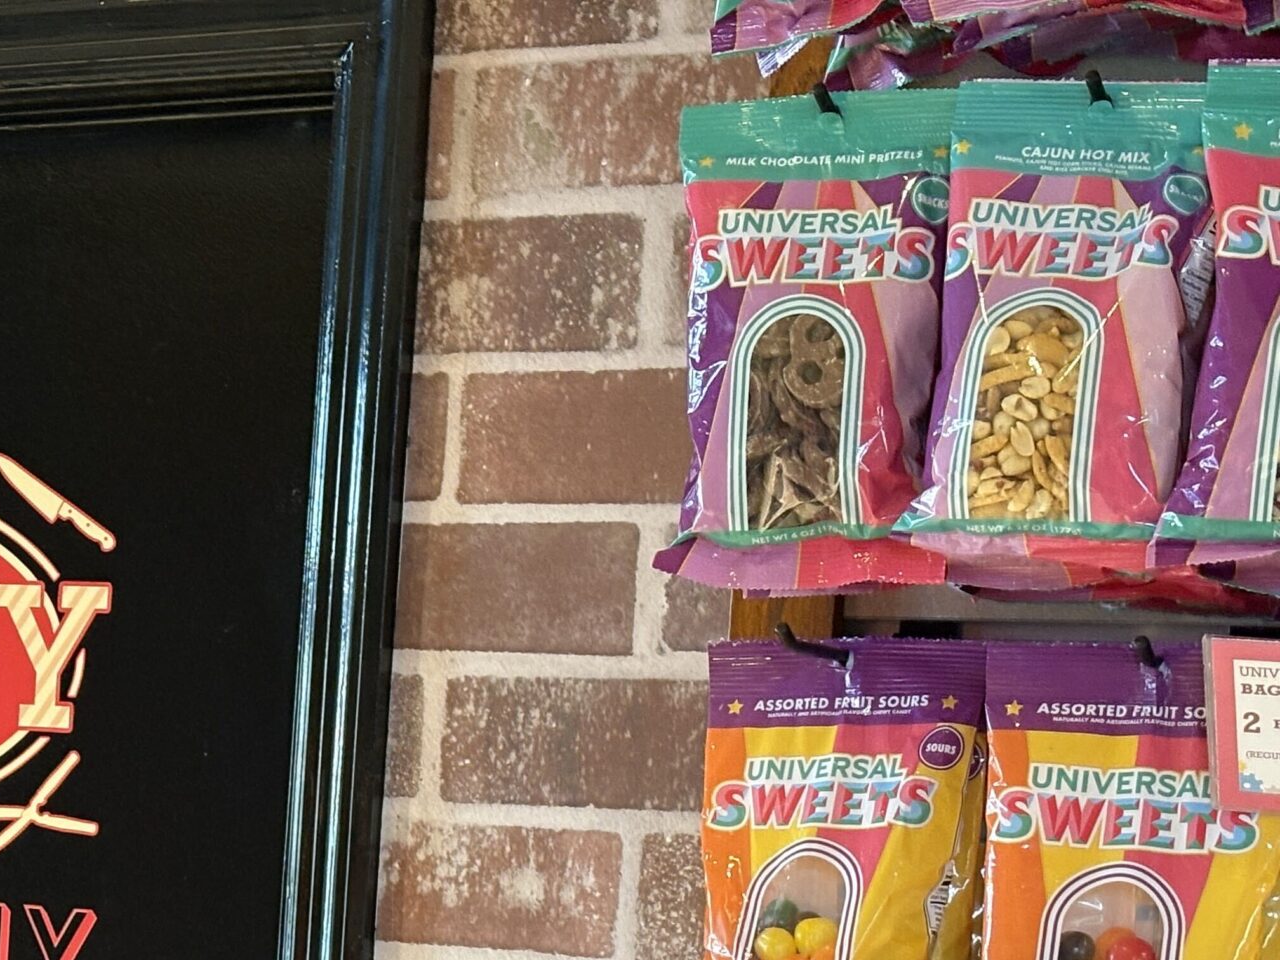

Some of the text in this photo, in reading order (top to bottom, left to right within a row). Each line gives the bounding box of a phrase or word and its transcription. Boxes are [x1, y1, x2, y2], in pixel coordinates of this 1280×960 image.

[725, 157, 757, 167] MILK
[835, 153, 865, 165] MINI
[869, 150, 923, 164] PRETZELS
[1021, 146, 1151, 164] CAJUN HOT MIX
[721, 204, 899, 234] UNIVERSAL
[972, 201, 1153, 233] UNIVERSAL
[696, 227, 934, 291] SWEETS
[944, 215, 1180, 282] SWEETS
[754, 694, 930, 712] ASSORTED FRUIT SOURS
[1037, 702, 1127, 718] ASSORTED
[1132, 704, 1179, 719] FRUIT
[1242, 711, 1262, 734] 2
[925, 743, 956, 755] SOURS
[747, 754, 904, 781] UNIVERSAL
[1031, 765, 1211, 799] UNIVERSAL
[708, 776, 938, 830] SWEETS
[991, 786, 1260, 855] SWEETS
